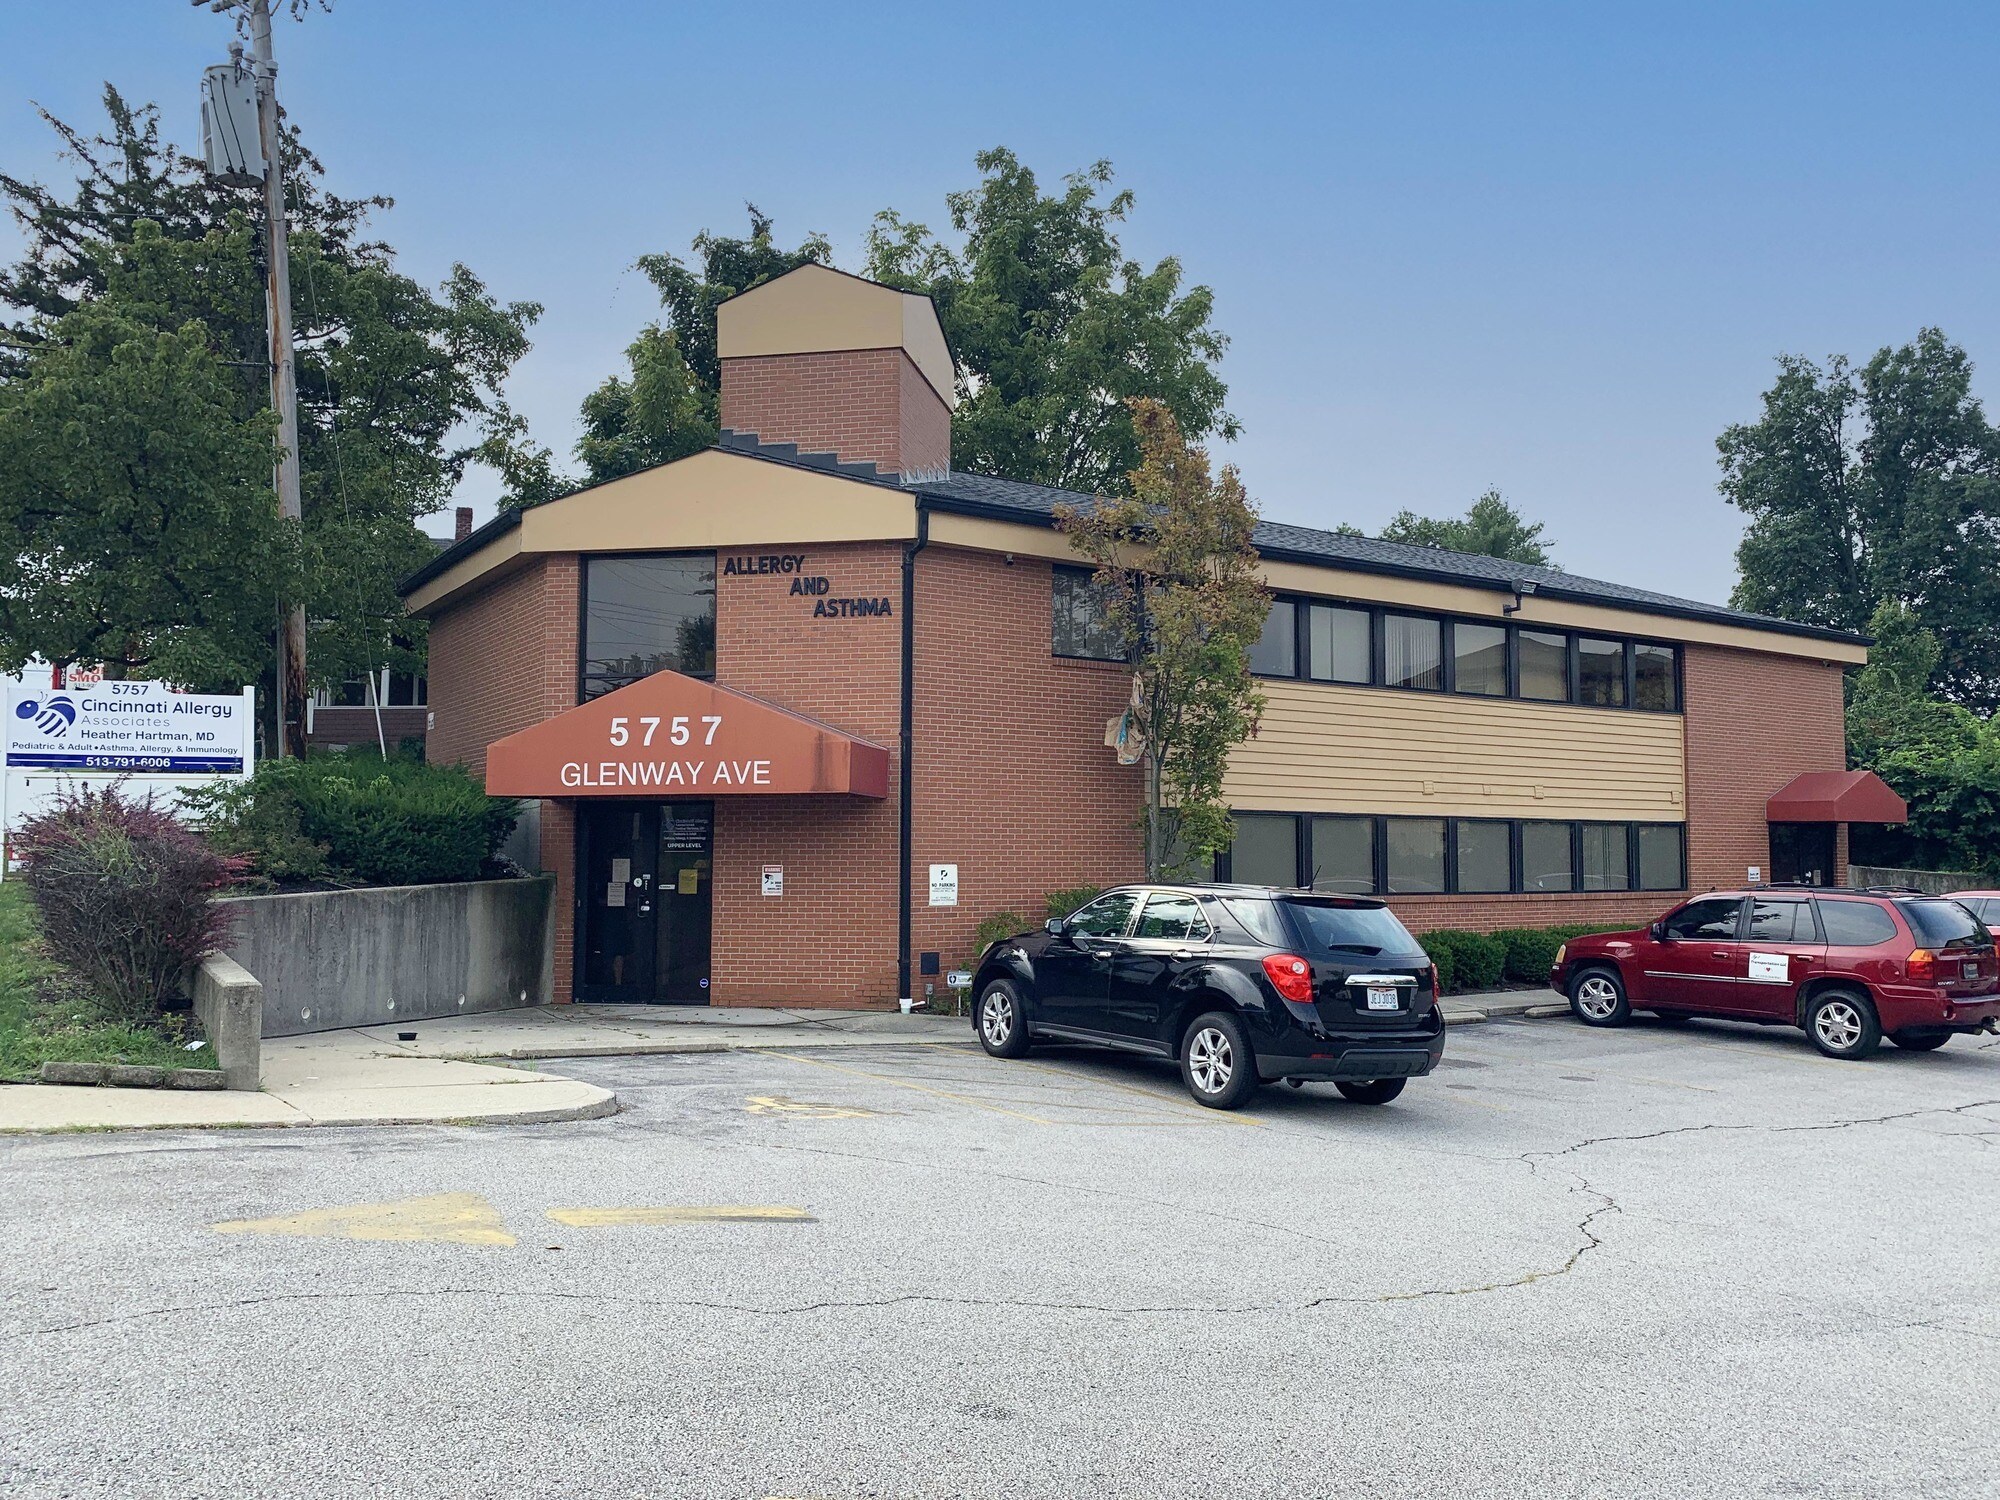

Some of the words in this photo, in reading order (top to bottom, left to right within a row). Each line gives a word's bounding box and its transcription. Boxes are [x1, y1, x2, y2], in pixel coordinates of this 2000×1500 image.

[723, 555, 805, 576] ALLERGY
[789, 577, 830, 596] AND
[813, 598, 893, 618] ASTHMA
[111, 684, 149, 696] 5757
[81, 698, 168, 713] Cincinnati
[172, 701, 232, 718] Allergy
[81, 715, 171, 727] Associates
[81, 729, 132, 740] Heather
[135, 731, 192, 742] Hartman,
[196, 732, 215, 741] MD
[609, 716, 722, 747] 5757
[12, 742, 56, 750] Pediatric
[58, 742, 65, 750] &
[67, 743, 93, 752] Adult
[139, 745, 174, 754] Allergy,
[185, 746, 238, 755] Immunology
[85, 756, 171, 768] 513-791-6006
[560, 761, 704, 786] GLENWAY
[712, 760, 771, 785] AVE
